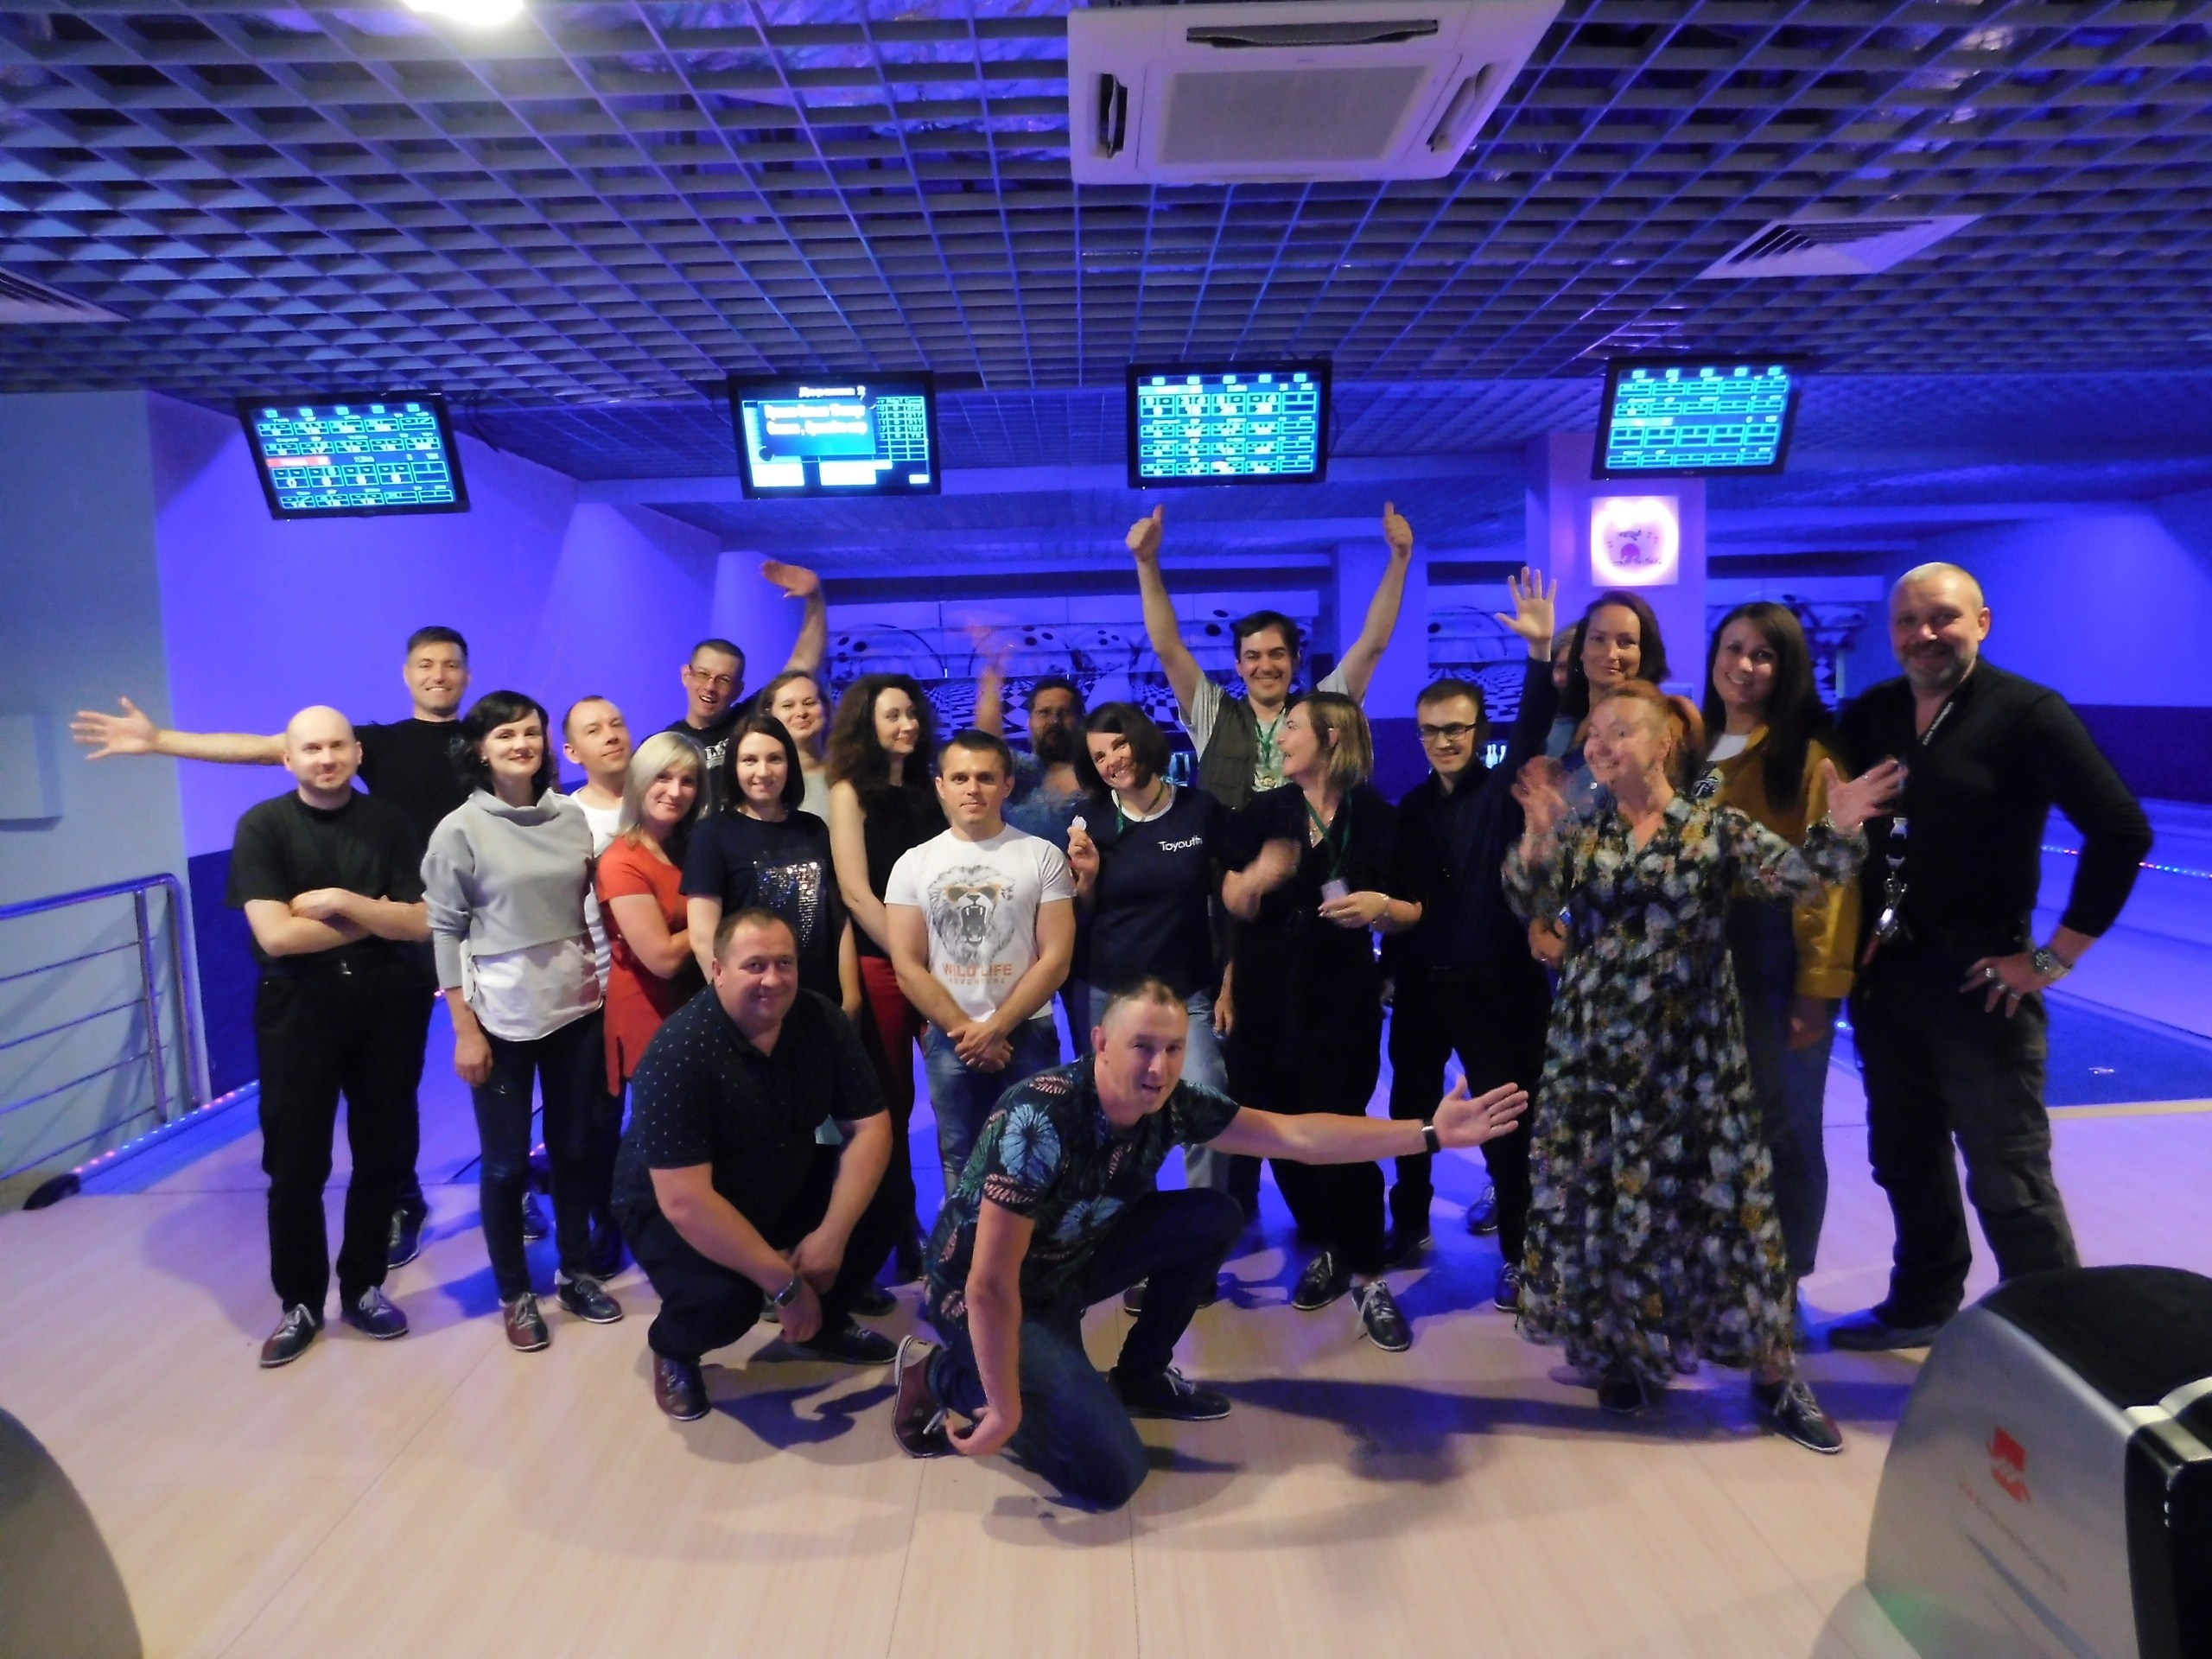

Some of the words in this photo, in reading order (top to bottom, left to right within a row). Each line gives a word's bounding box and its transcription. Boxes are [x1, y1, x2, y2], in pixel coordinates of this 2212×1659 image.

[1158, 835, 1203, 852] Toyouth
[943, 963, 977, 977] WILD
[981, 963, 1013, 976] LIFE
